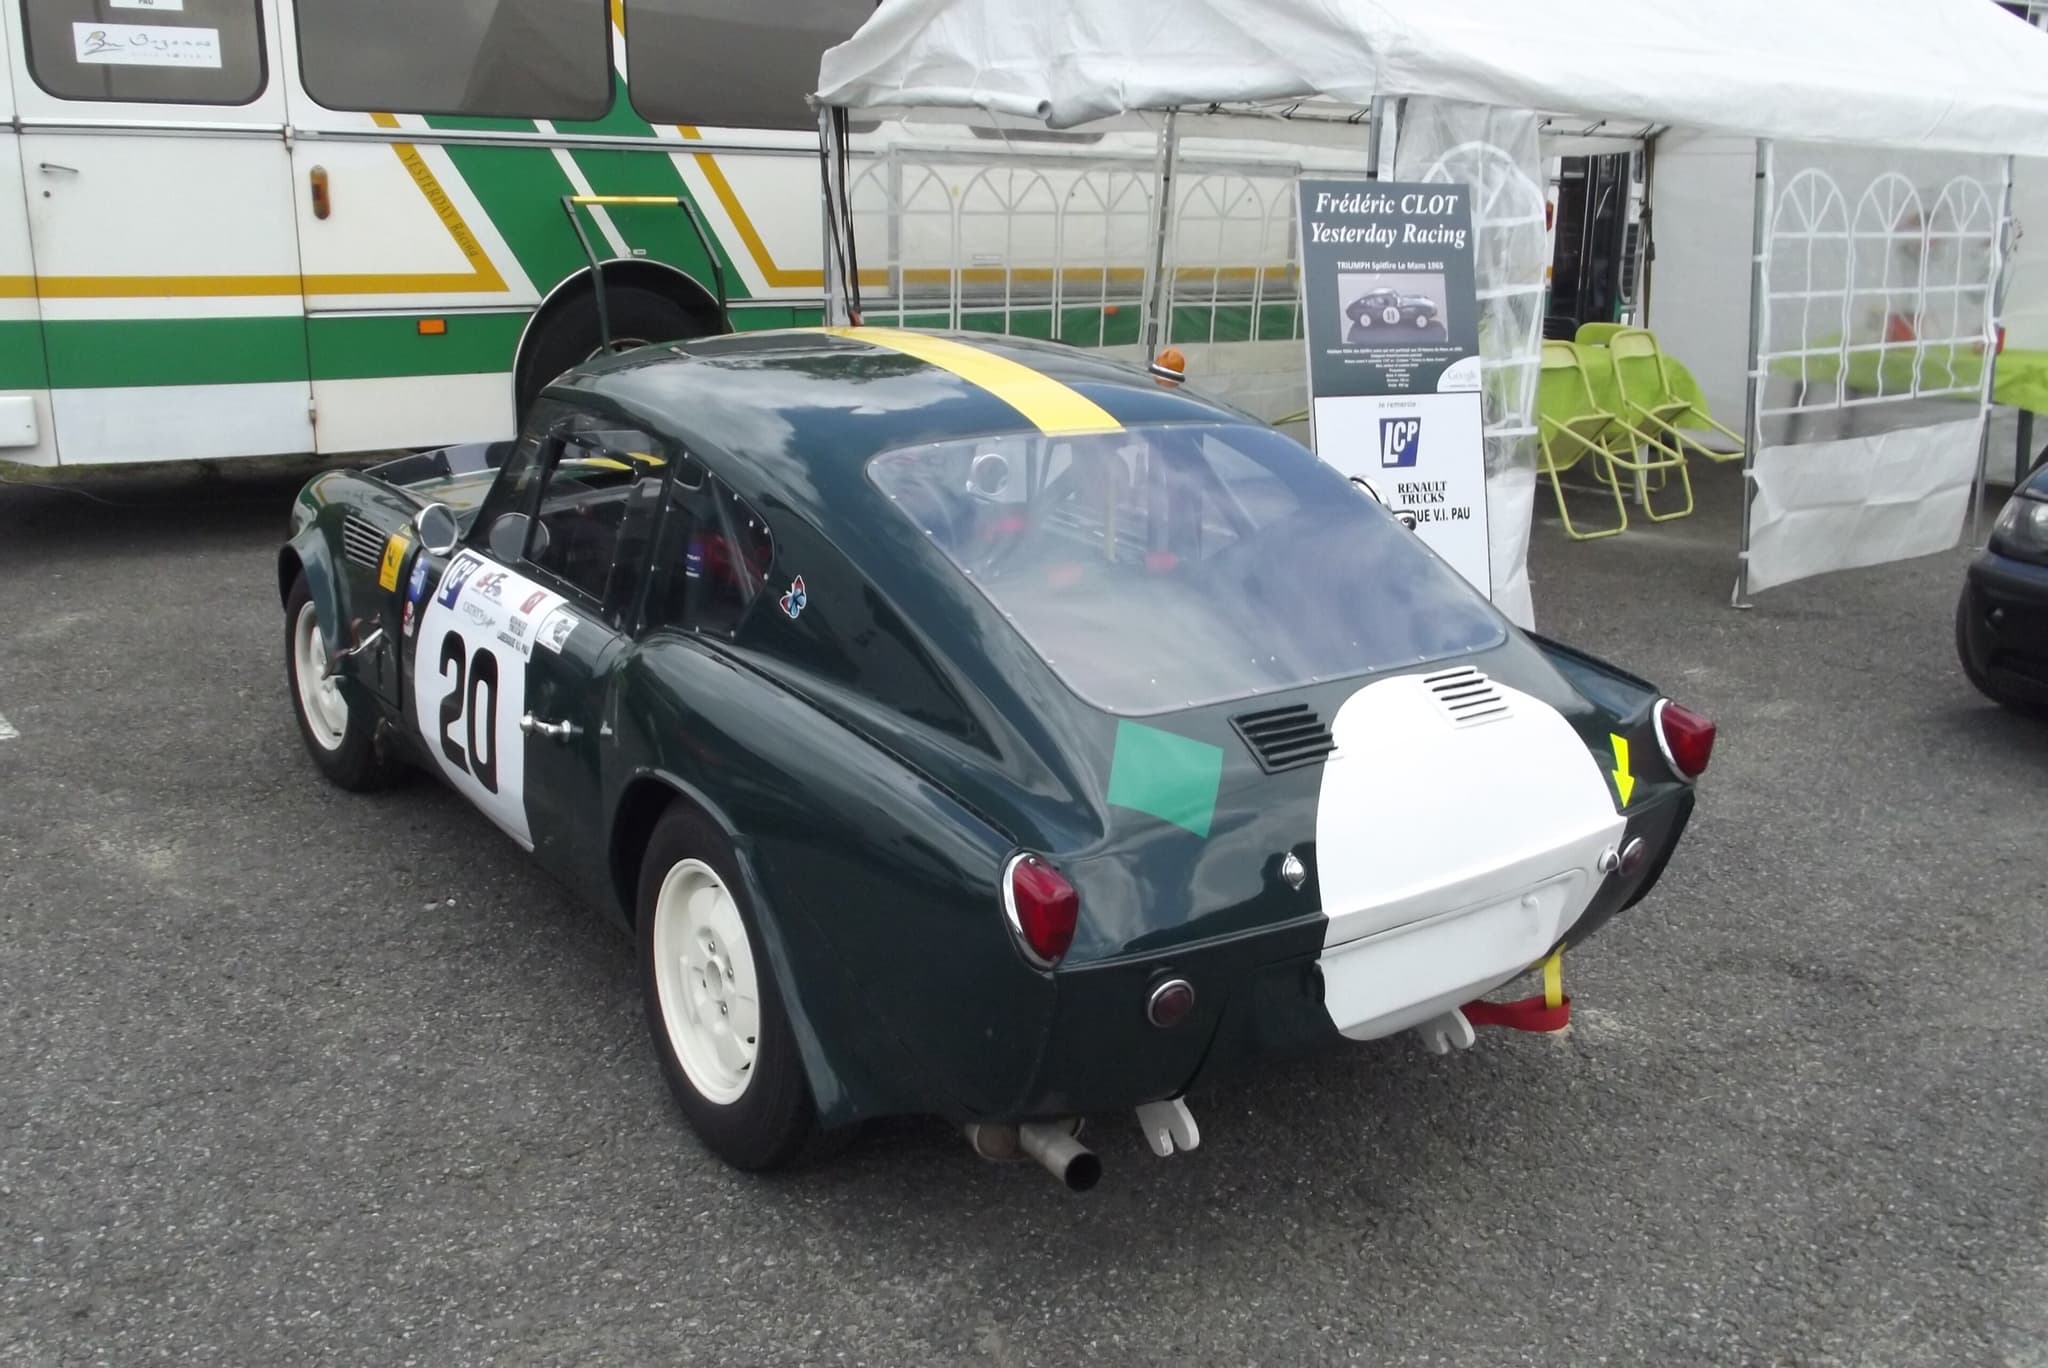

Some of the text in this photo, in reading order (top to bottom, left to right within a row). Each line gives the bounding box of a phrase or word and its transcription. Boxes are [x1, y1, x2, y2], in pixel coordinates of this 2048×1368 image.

[405, 153, 479, 257] YESTERDAY Racing
[1315, 192, 1459, 215] Frédéric CLOT
[1311, 222, 1467, 249] Yesterday Racing
[1337, 261, 1371, 269] TRIUMPH
[1371, 262, 1397, 271] Spitfire
[1398, 262, 1406, 270] Le
[1407, 262, 1426, 270] Mans
[1383, 421, 1418, 464] LCP
[1398, 481, 1447, 493] RENAULT
[1400, 492, 1445, 504] TRUCKS
[1433, 508, 1449, 521] V.I.
[1451, 507, 1471, 520] PAU
[440, 556, 480, 601] LCP
[439, 630, 498, 794] 20
